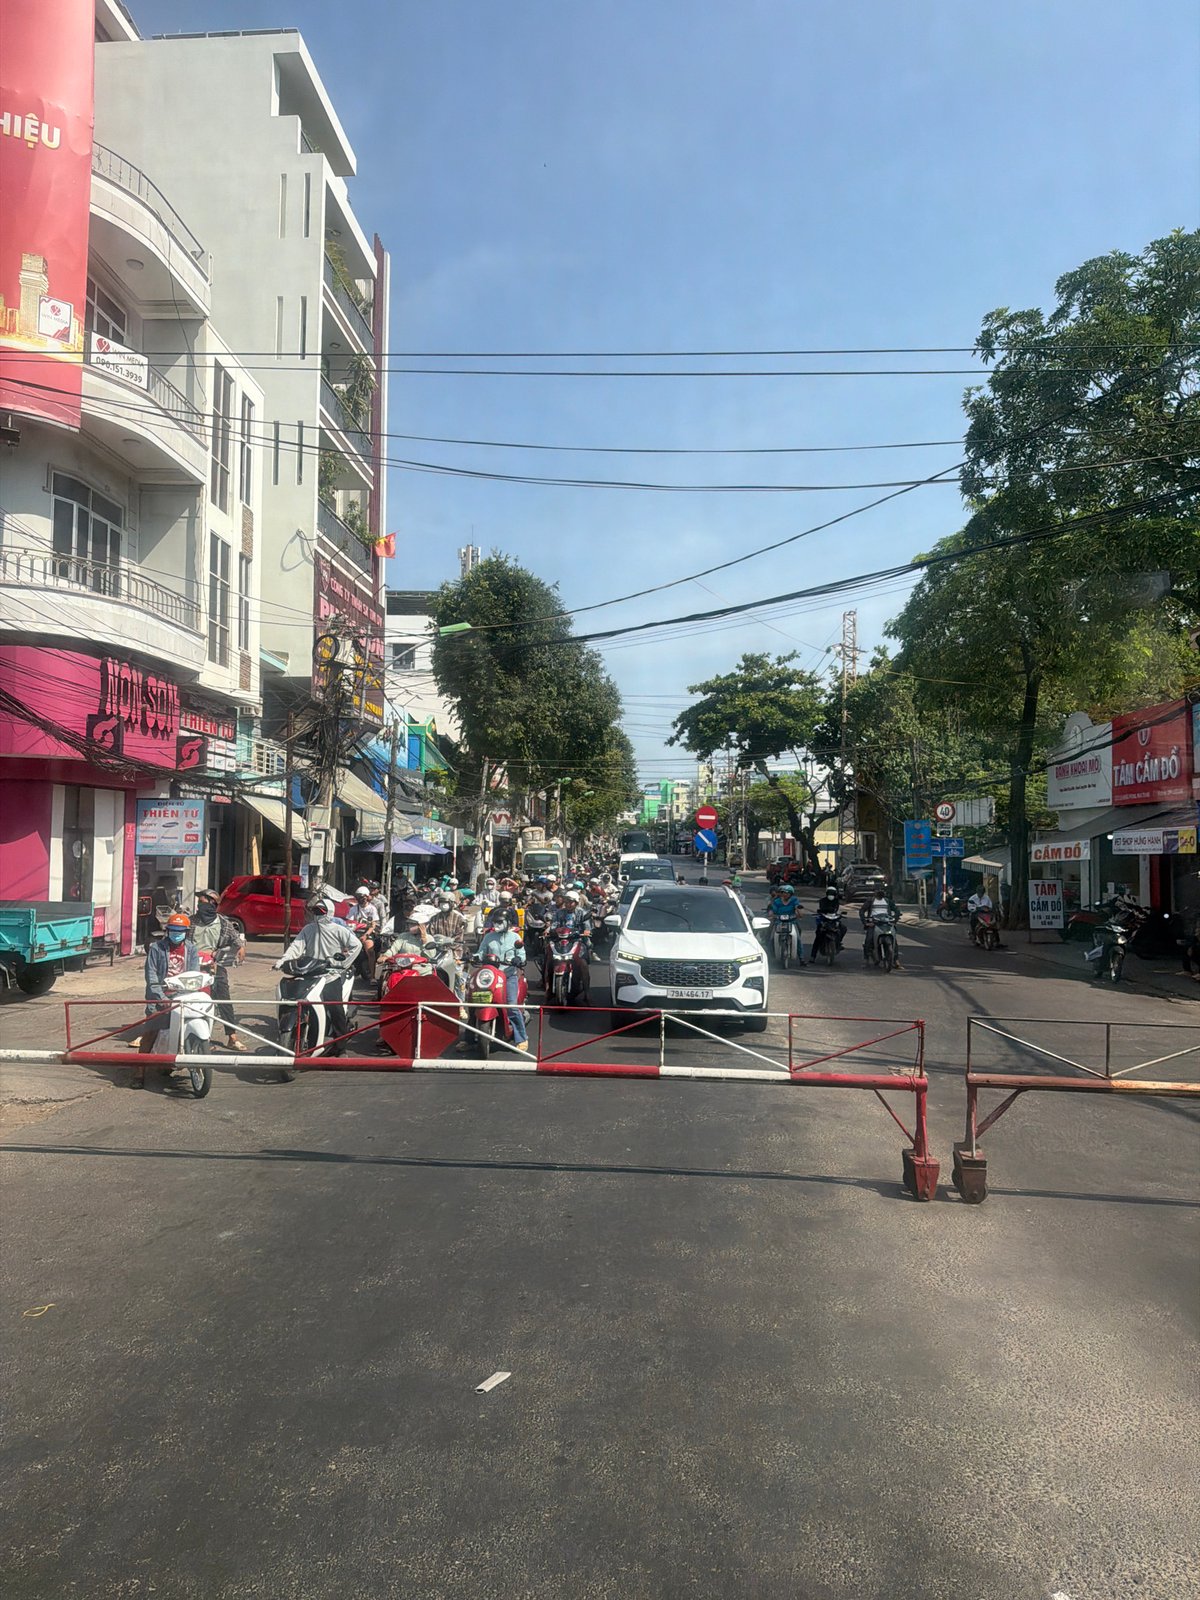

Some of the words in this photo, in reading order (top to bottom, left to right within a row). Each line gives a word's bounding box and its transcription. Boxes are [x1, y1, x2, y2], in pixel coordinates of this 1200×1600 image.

[96, 356, 143, 384] 090.151.3939
[1113, 759, 1134, 787] TÂM
[143, 808, 179, 818] THIÊN
[940, 807, 950, 817] 40
[1034, 844, 1062, 861] CẦM
[1034, 881, 1057, 896] TÂM
